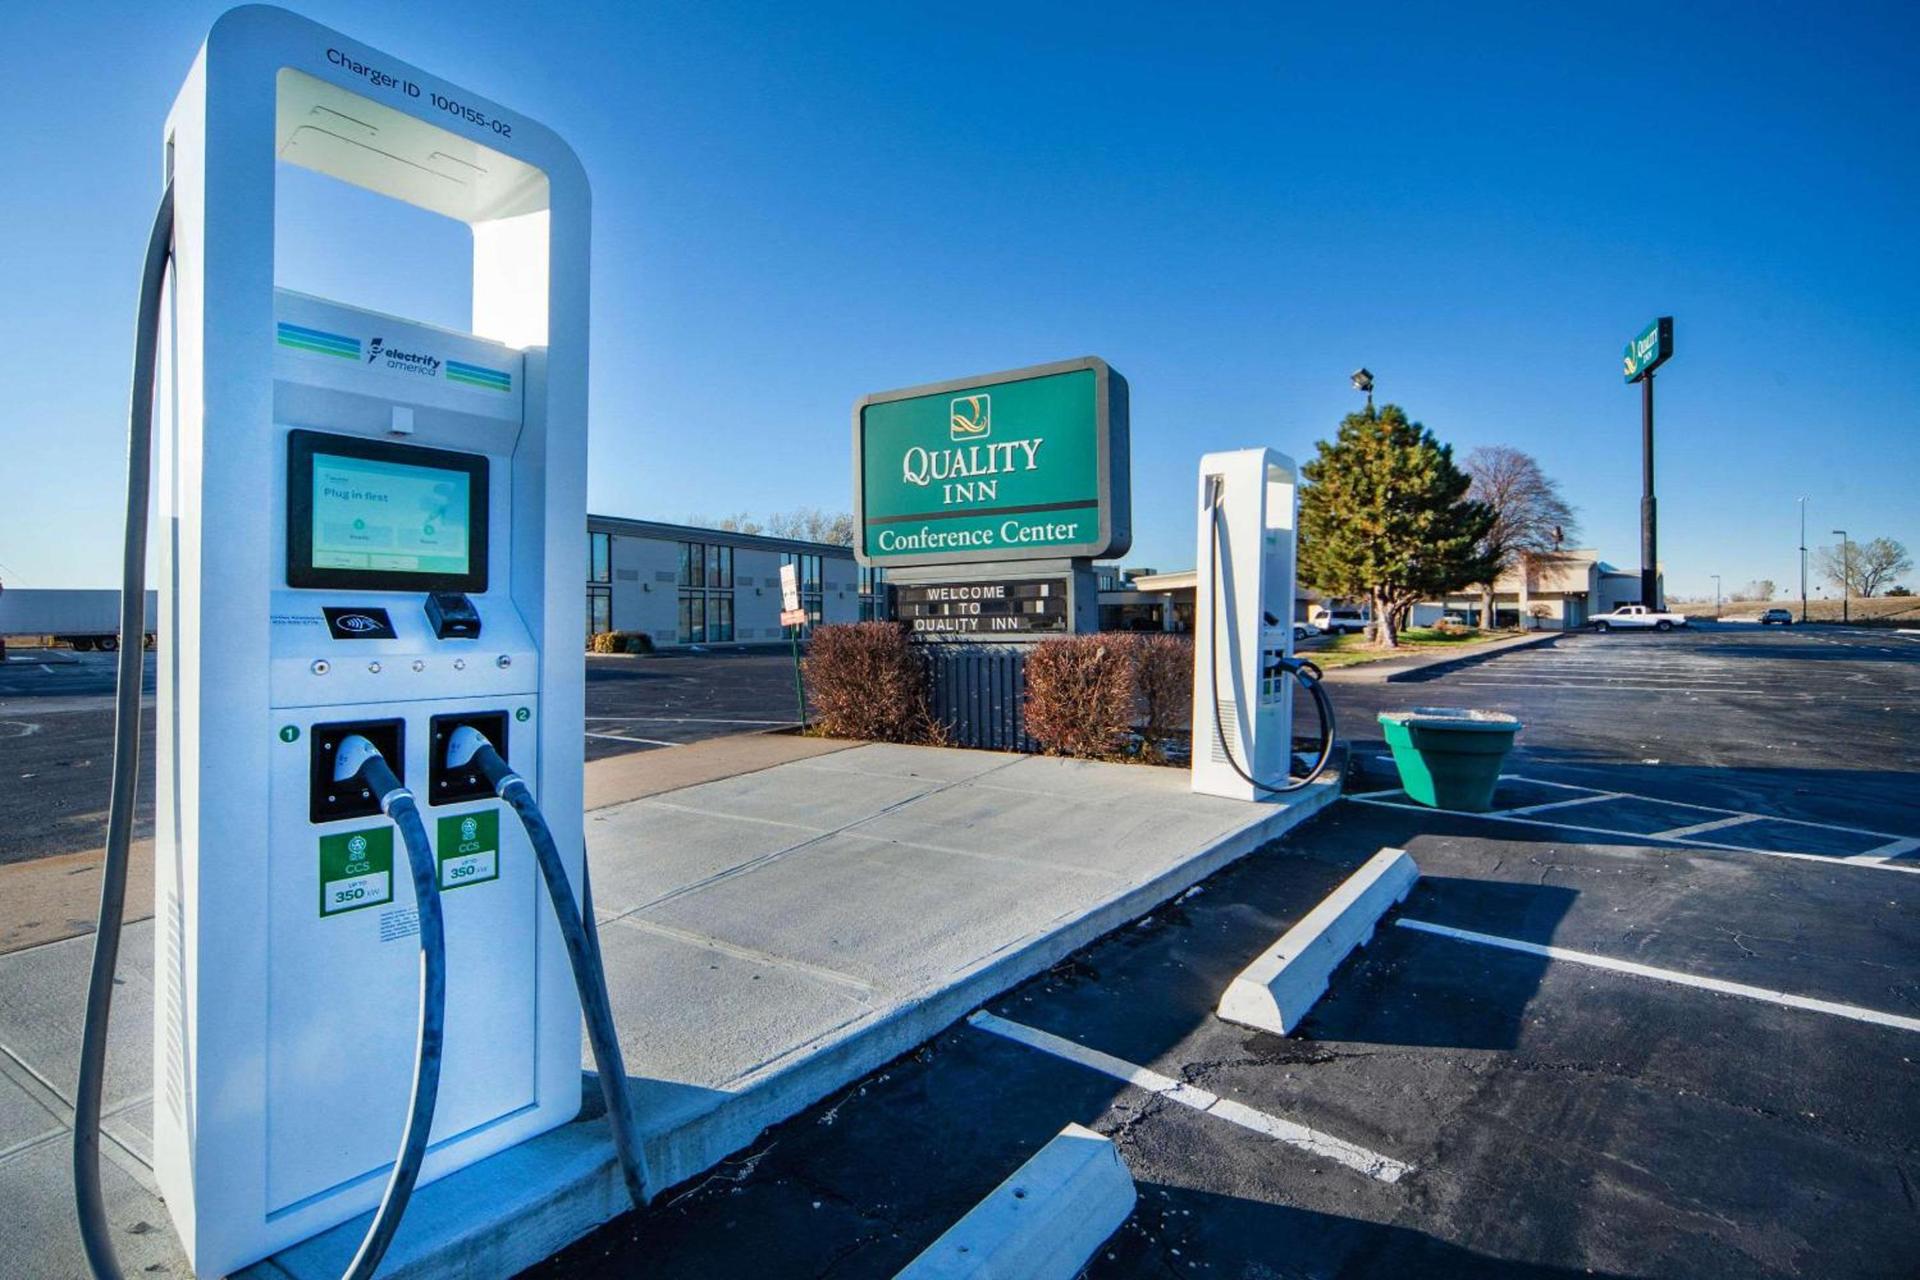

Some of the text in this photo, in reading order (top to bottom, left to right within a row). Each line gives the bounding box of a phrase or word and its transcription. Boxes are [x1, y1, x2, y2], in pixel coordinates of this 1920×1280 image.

[326, 48, 512, 138] Charger ID 100155-02
[385, 349, 441, 369] electrify
[386, 359, 437, 377] america
[903, 438, 1044, 486] QUALITY
[324, 486, 389, 503] Plug in first
[943, 480, 998, 504] INN
[879, 520, 1078, 551] Conference Center
[927, 585, 1005, 600] WELCOME
[959, 602, 981, 615] TO
[915, 617, 1019, 632] QUALITY INN
[458, 841, 480, 853] CCS
[345, 861, 370, 874] CCS
[450, 865, 475, 879] 350
[335, 887, 364, 904] 350
